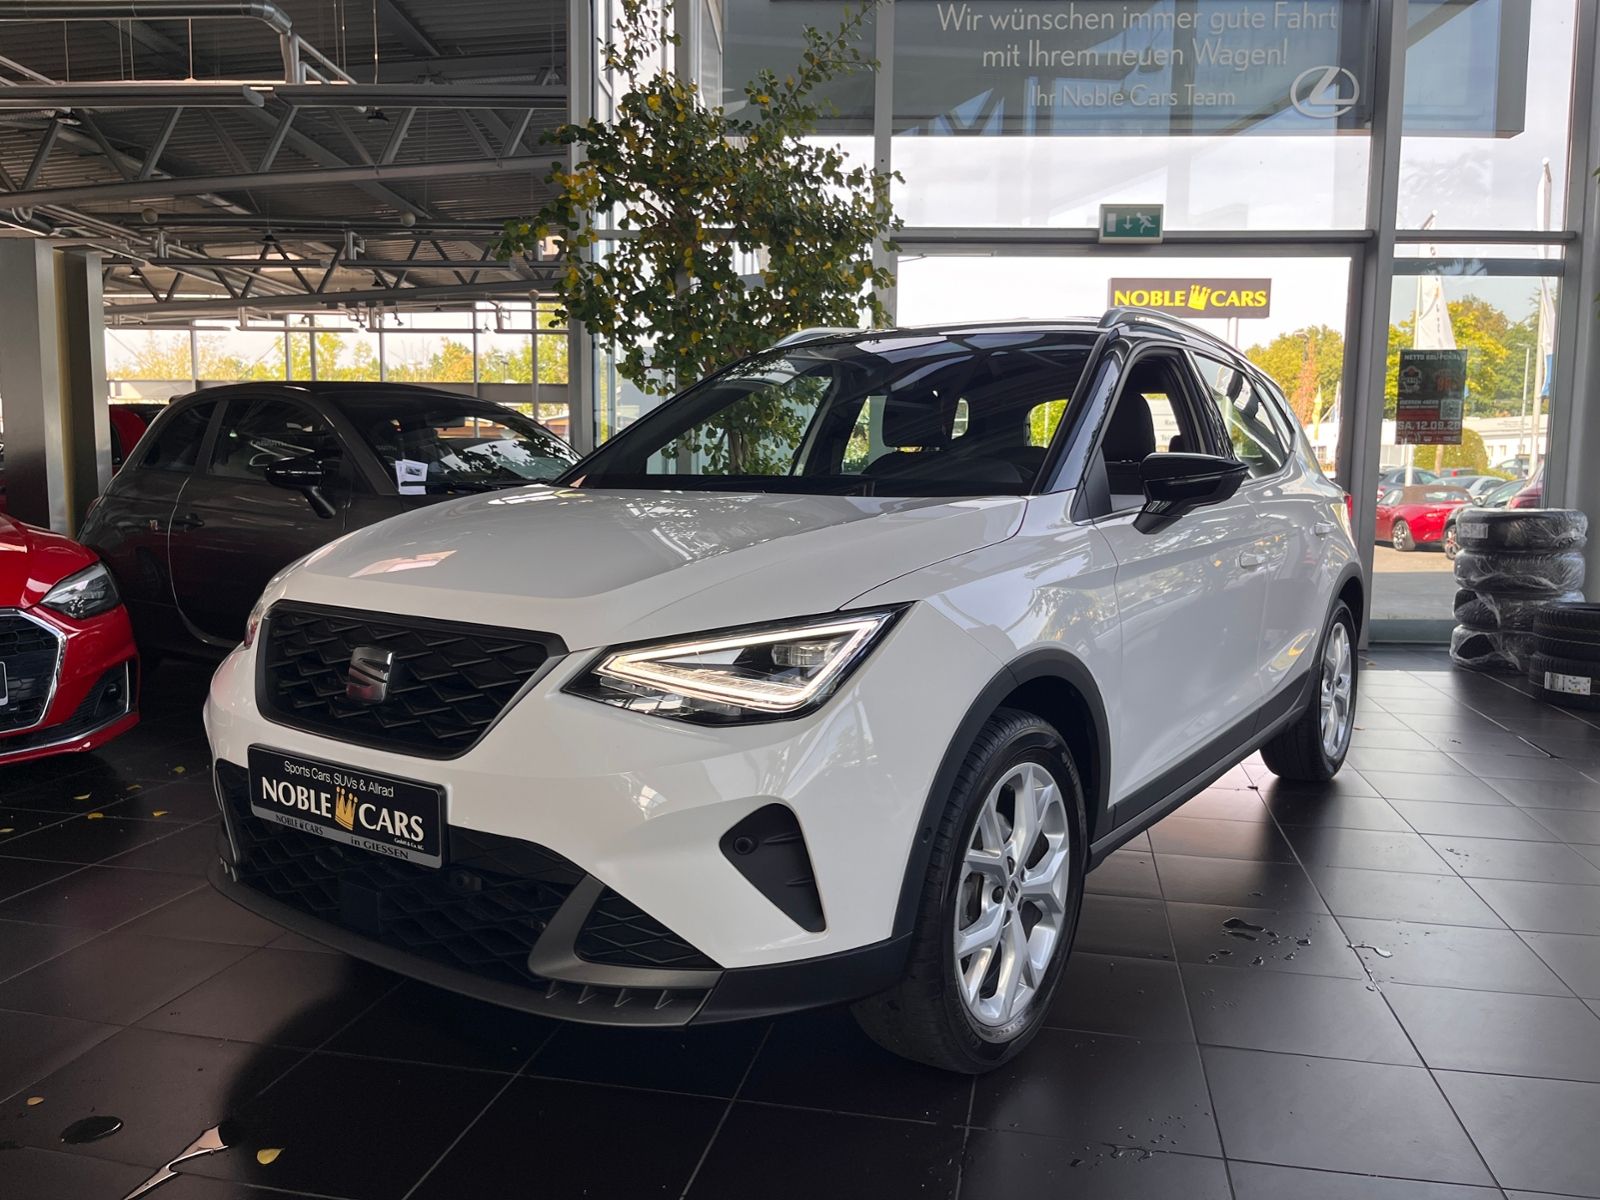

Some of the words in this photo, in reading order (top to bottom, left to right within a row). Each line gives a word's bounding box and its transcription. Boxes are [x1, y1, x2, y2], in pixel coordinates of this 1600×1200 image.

[937, 3, 982, 31] Wir
[989, 3, 1114, 31] wünschen
[1123, 6, 1202, 31] immer
[1210, 6, 1265, 35] gute
[1274, 1, 1337, 30] Fahrt
[983, 44, 1020, 67] mit
[1028, 39, 1099, 67] Ihrem
[1107, 48, 1184, 67] neuen
[1192, 38, 1288, 71] Wagen!
[1031, 85, 1056, 106] Ihr
[1062, 85, 1124, 107] Noble
[1130, 84, 1178, 106] Cars
[1184, 83, 1236, 106] Team
[1114, 289, 1186, 307] NOBLE
[1210, 290, 1267, 307] CARS
[284, 760, 311, 777] Sports
[311, 767, 333, 784] Cars,
[333, 773, 358, 790] SUVs
[359, 779, 366, 792] &
[368, 782, 394, 798] Allrad
[261, 776, 332, 819] NOBLE
[358, 803, 424, 842] CARS
[275, 814, 299, 828] NOBLE
[304, 824, 325, 836] CARS
[351, 836, 360, 845] in
[363, 840, 410, 860] GIESSEN
